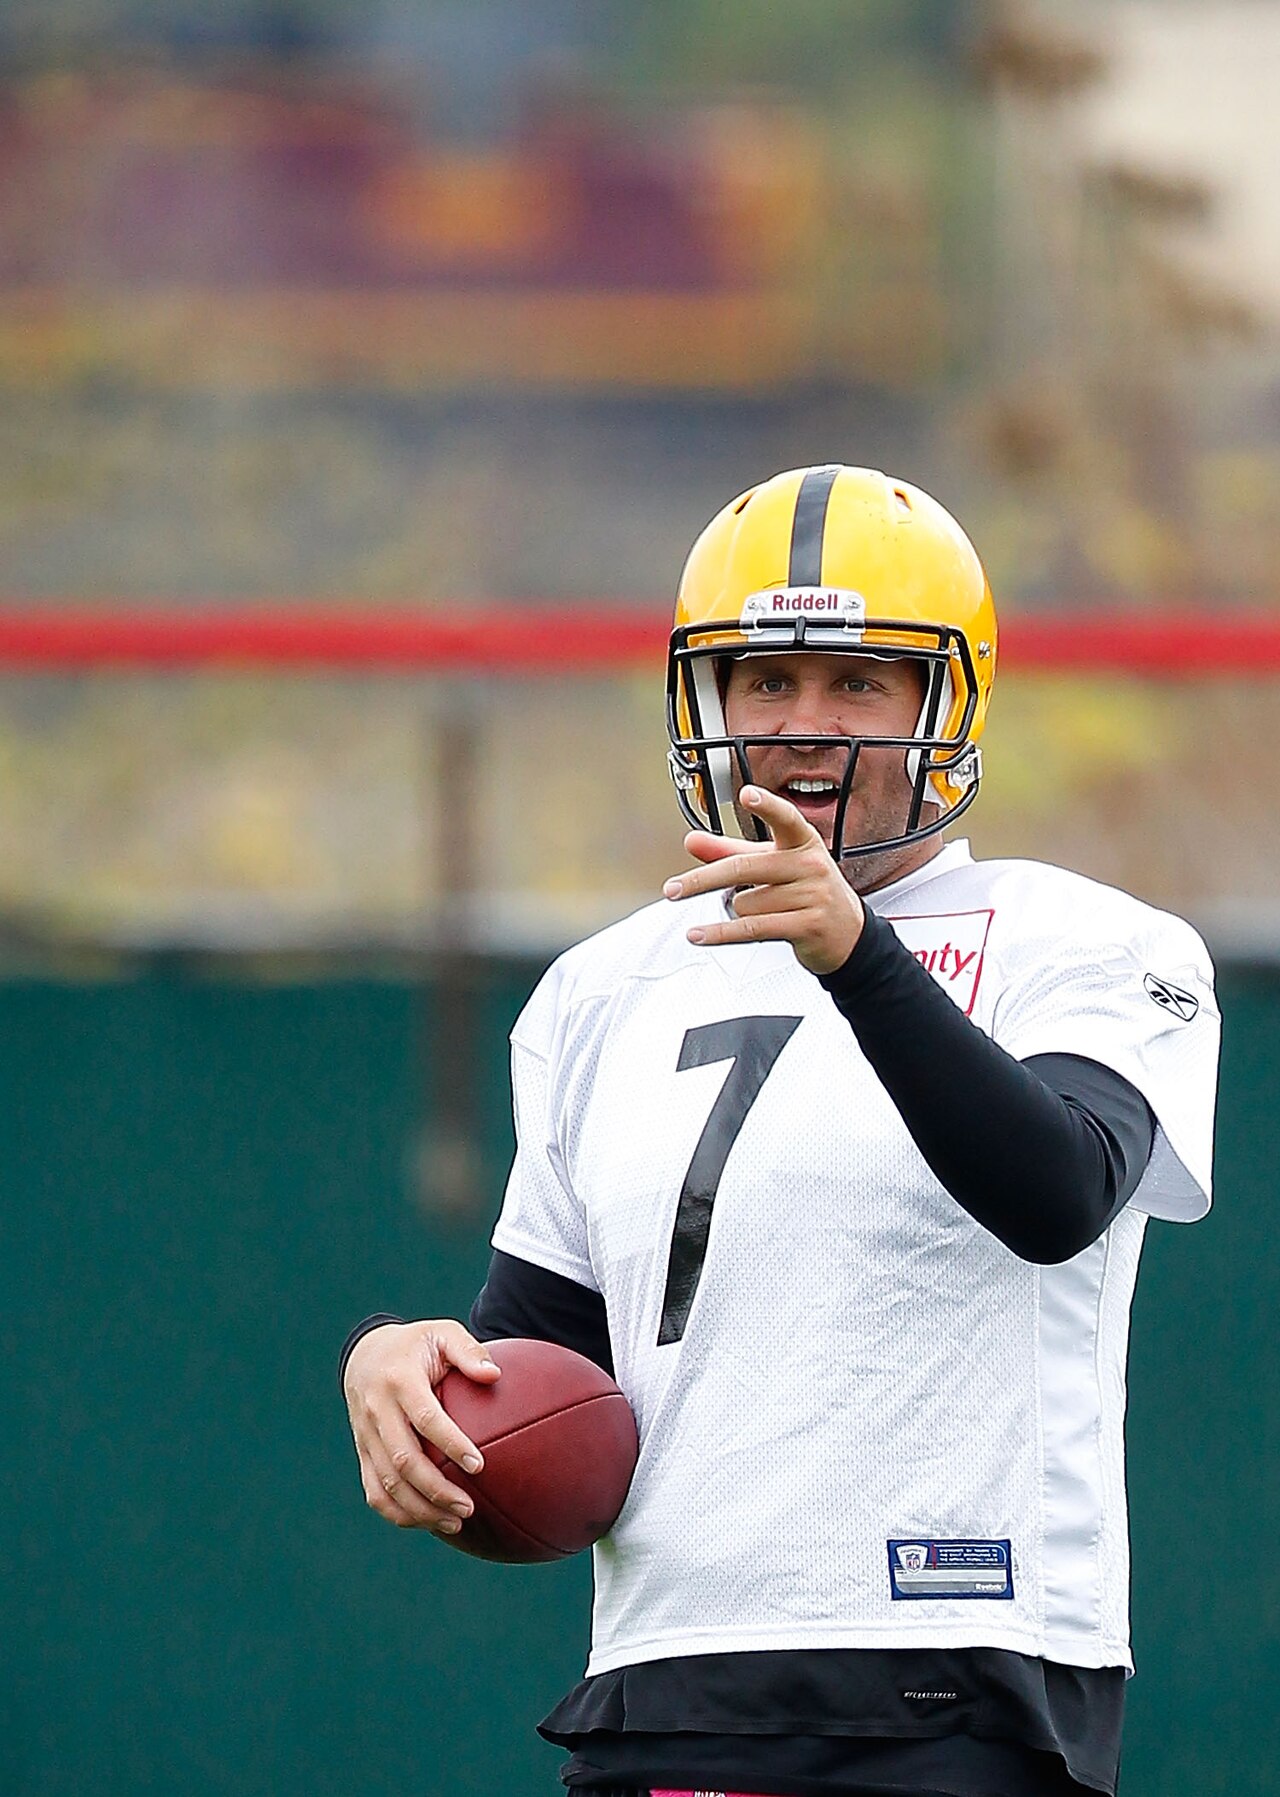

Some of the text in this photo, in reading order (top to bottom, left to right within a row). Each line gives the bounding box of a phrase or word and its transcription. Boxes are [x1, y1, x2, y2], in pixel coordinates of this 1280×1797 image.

[772, 594, 838, 611] Riddell
[912, 942, 978, 981] nity
[656, 1014, 805, 1347] 7
